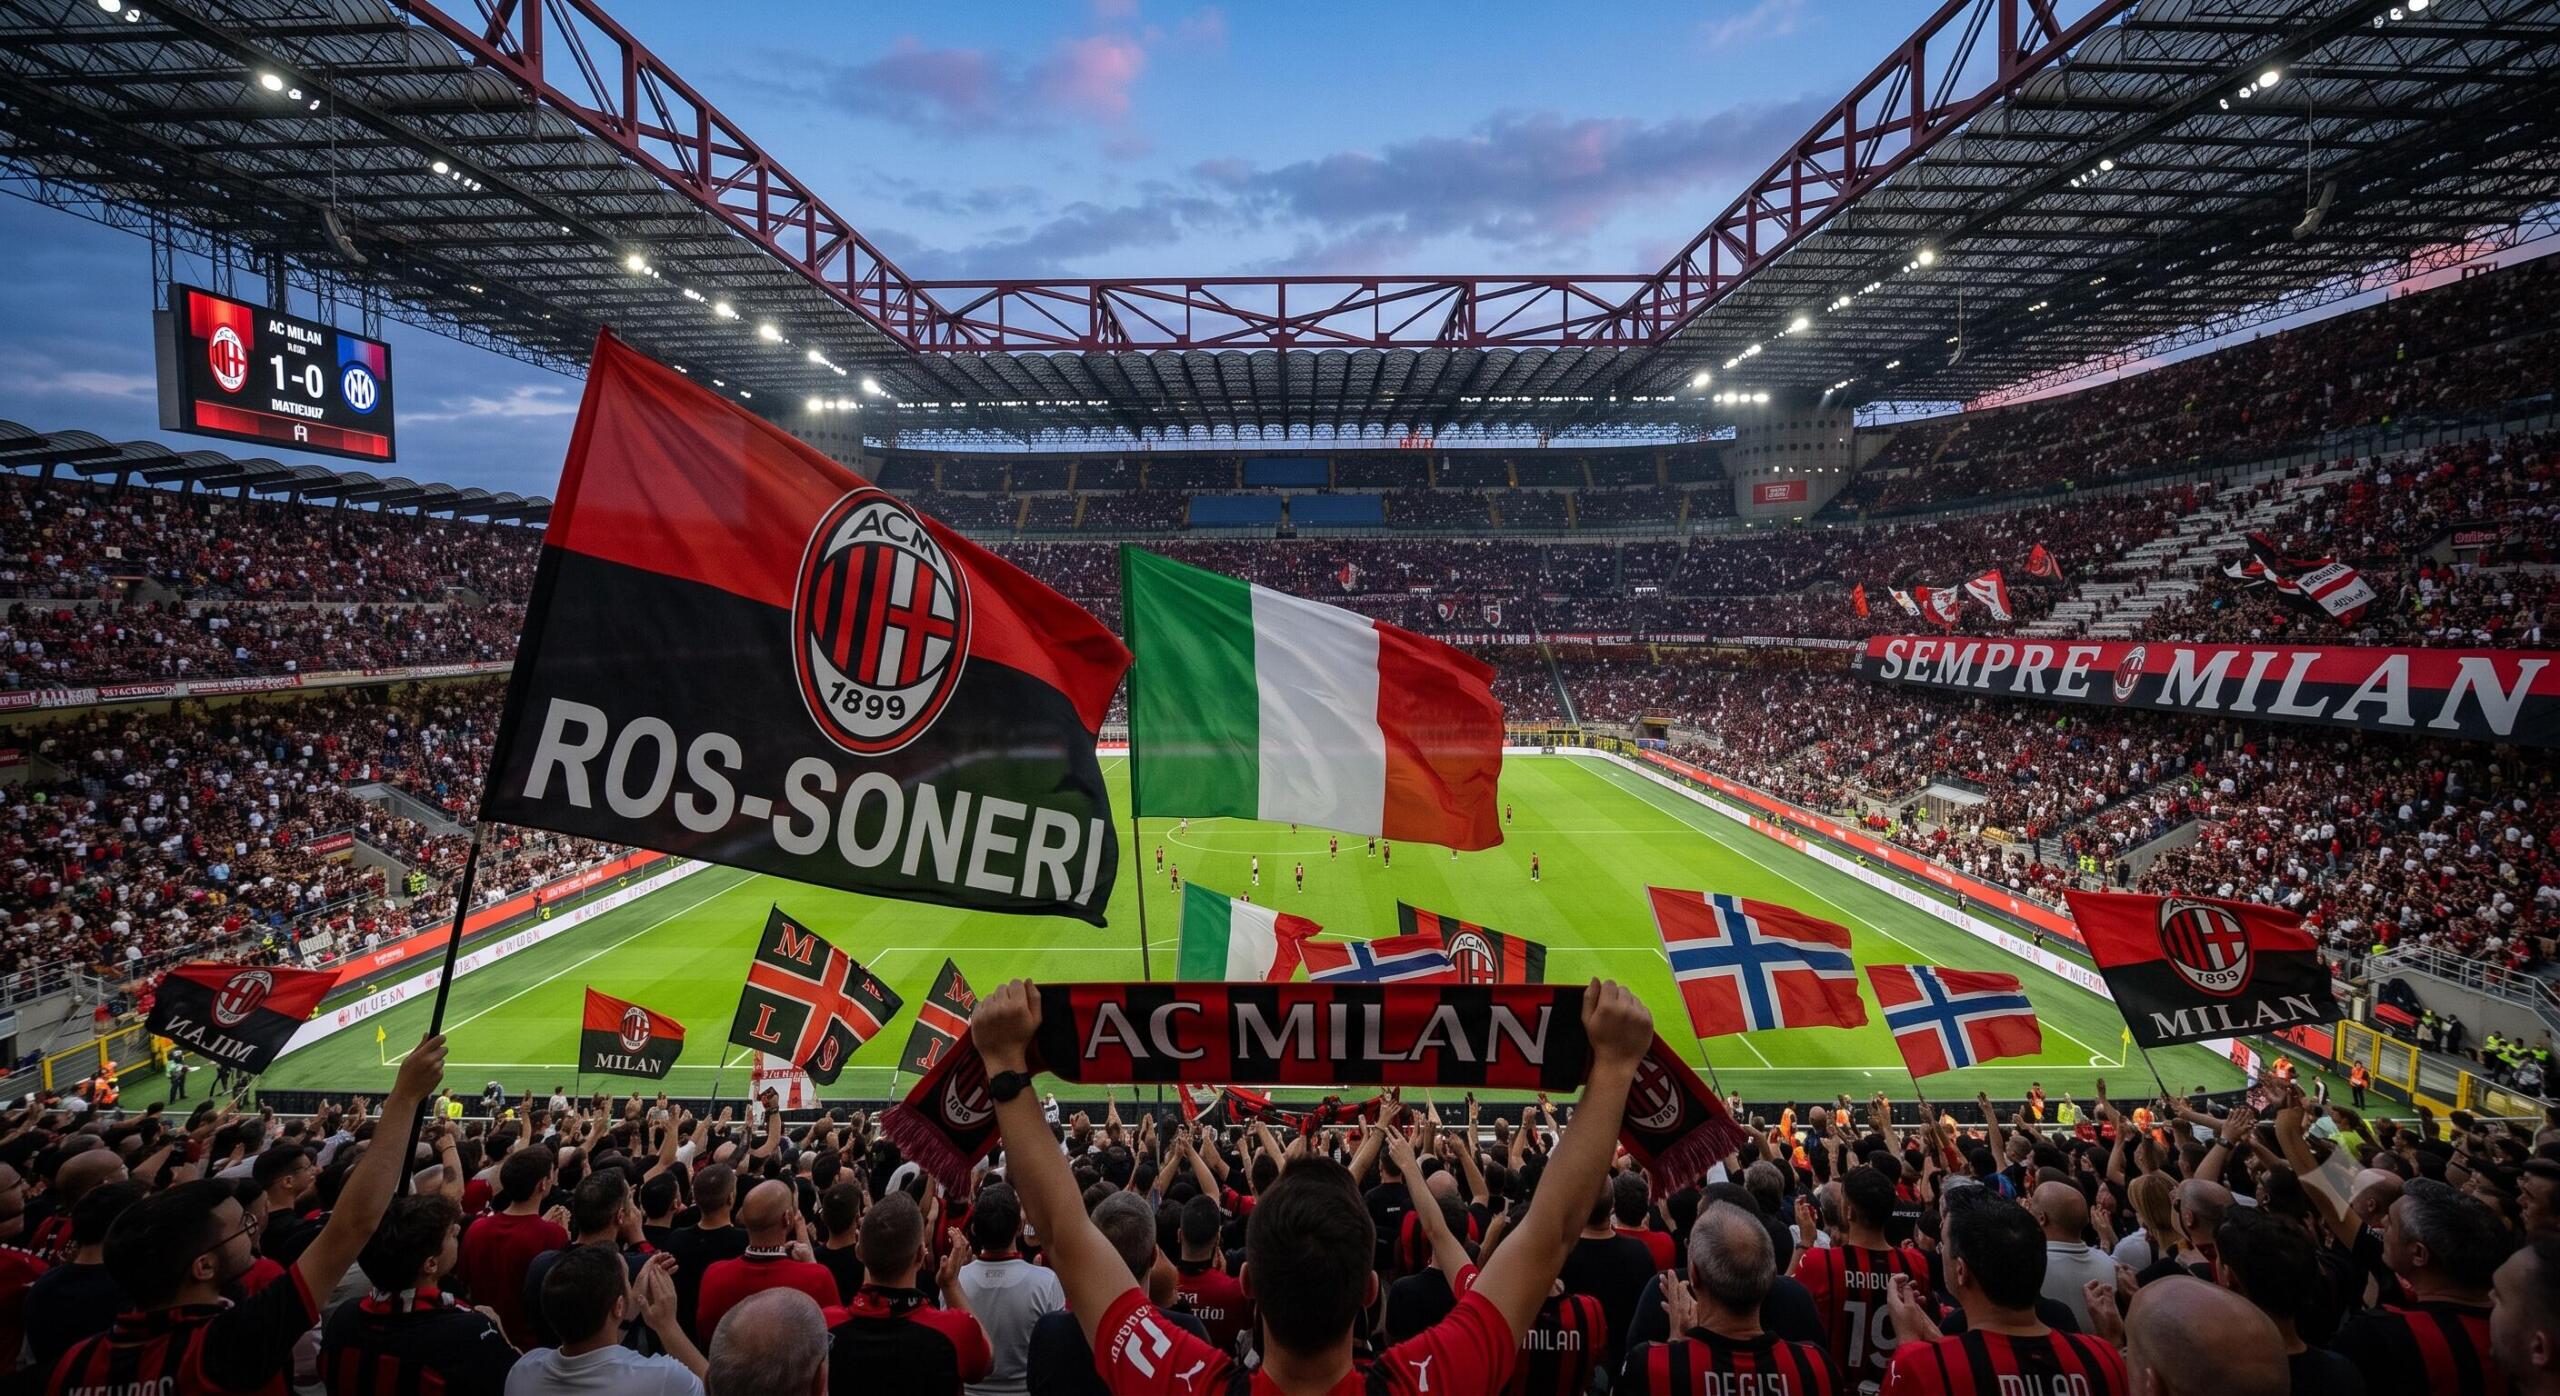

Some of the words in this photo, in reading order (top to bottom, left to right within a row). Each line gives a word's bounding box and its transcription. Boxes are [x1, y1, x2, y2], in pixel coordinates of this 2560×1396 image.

[269, 319, 285, 336] AC
[287, 324, 323, 346] MILAN
[848, 508, 939, 567] ACM
[829, 680, 907, 721] 1899
[1880, 638, 2102, 698] SEMPRE
[2155, 647, 2551, 736] MILAN
[522, 697, 1105, 907] ROS-SONERI
[773, 921, 820, 966] M
[1456, 936, 1486, 954] ACM
[2195, 969, 2240, 985] 1899
[1084, 1002, 1205, 1060] AC
[1233, 1002, 1553, 1065] MILAN
[2149, 993, 2321, 1040] MILAN
[594, 1052, 661, 1074] MILAN
